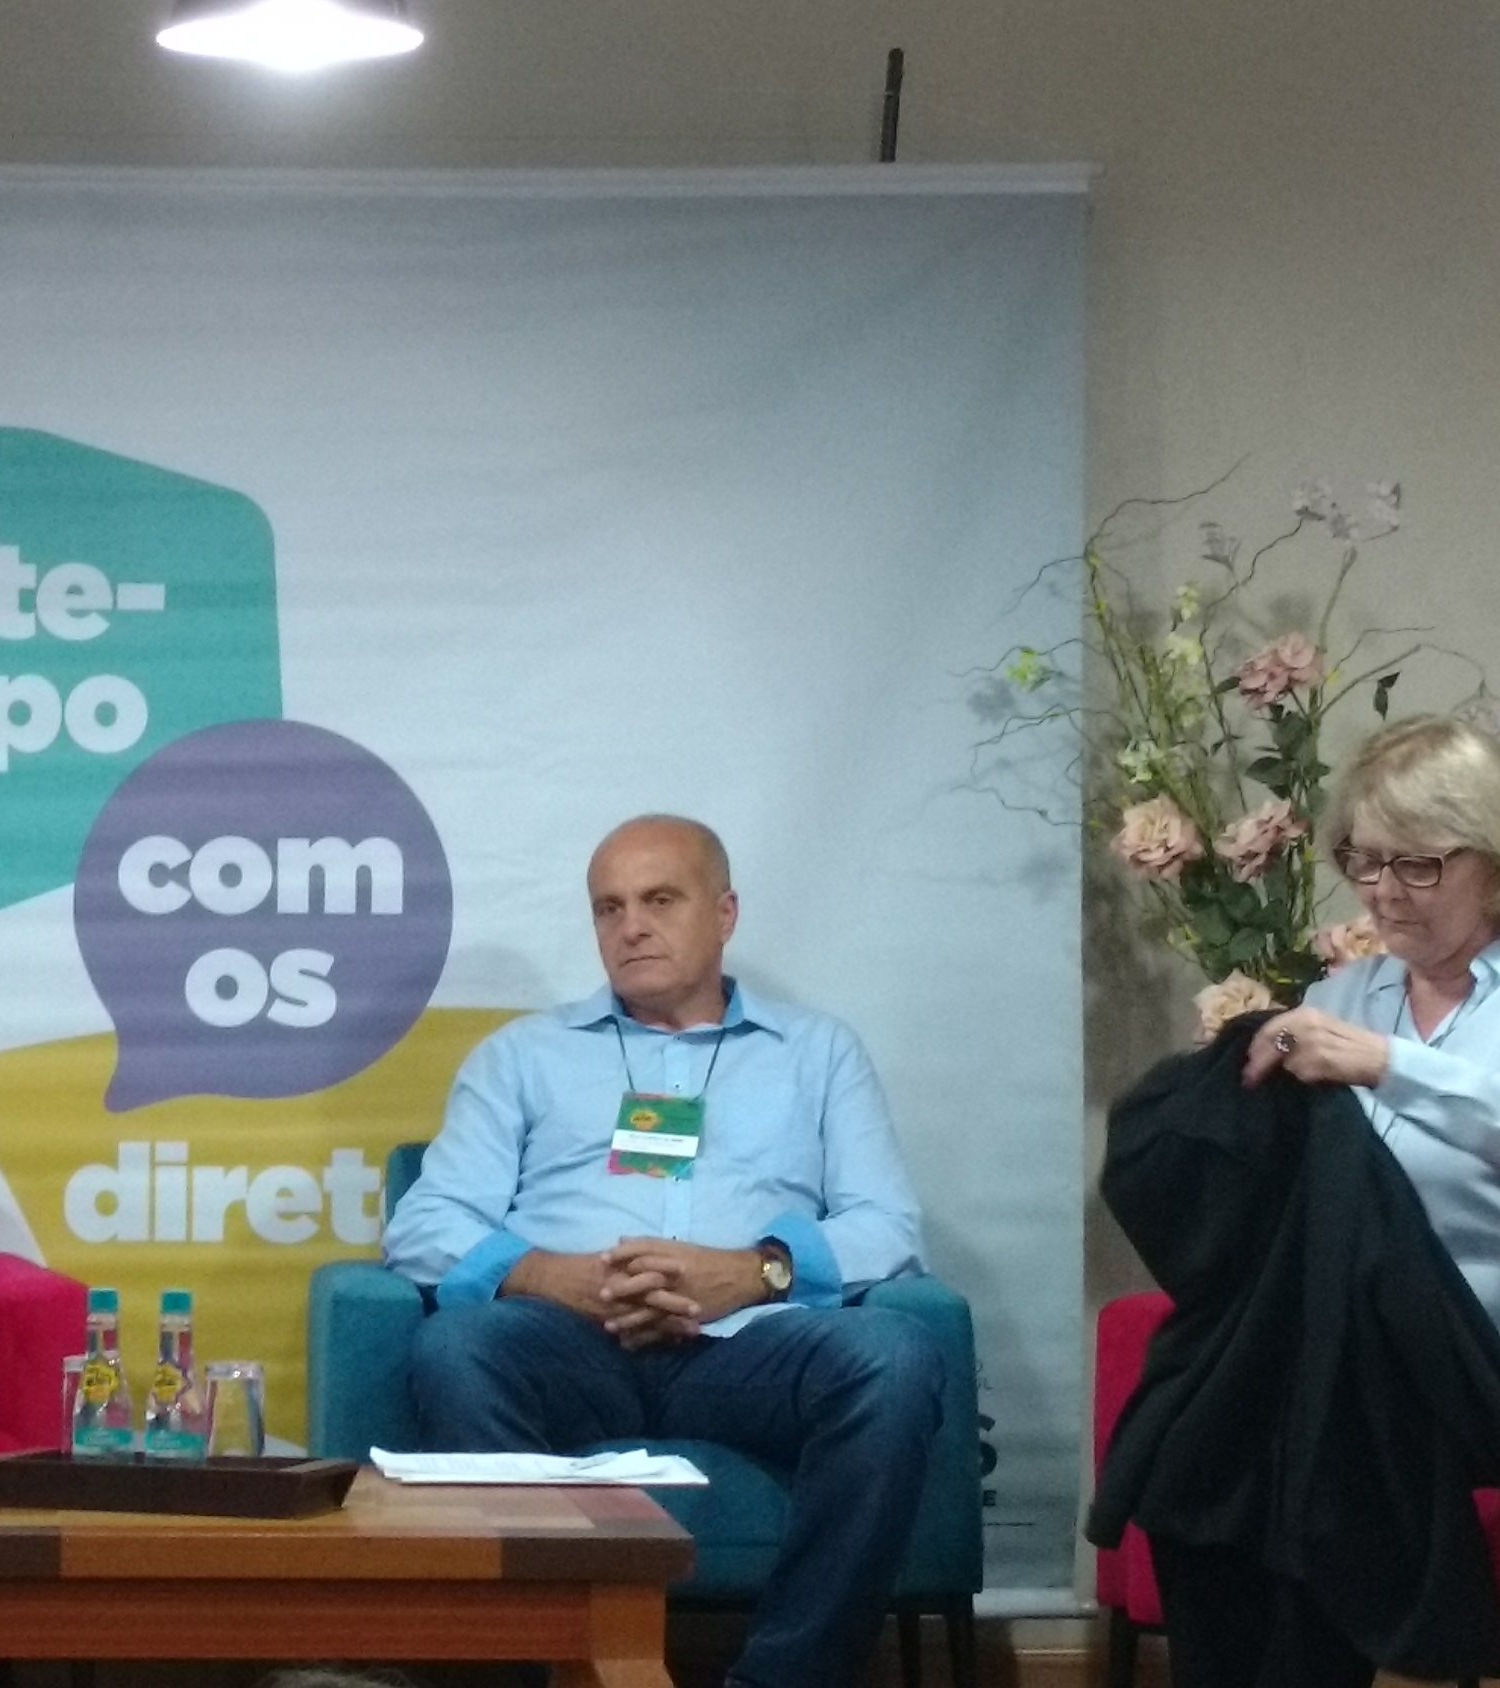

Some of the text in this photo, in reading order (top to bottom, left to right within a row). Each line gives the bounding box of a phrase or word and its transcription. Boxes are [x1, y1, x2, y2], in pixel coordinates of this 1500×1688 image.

[117, 835, 404, 915] com
[184, 948, 337, 1025] os
[63, 1141, 387, 1245] diret
